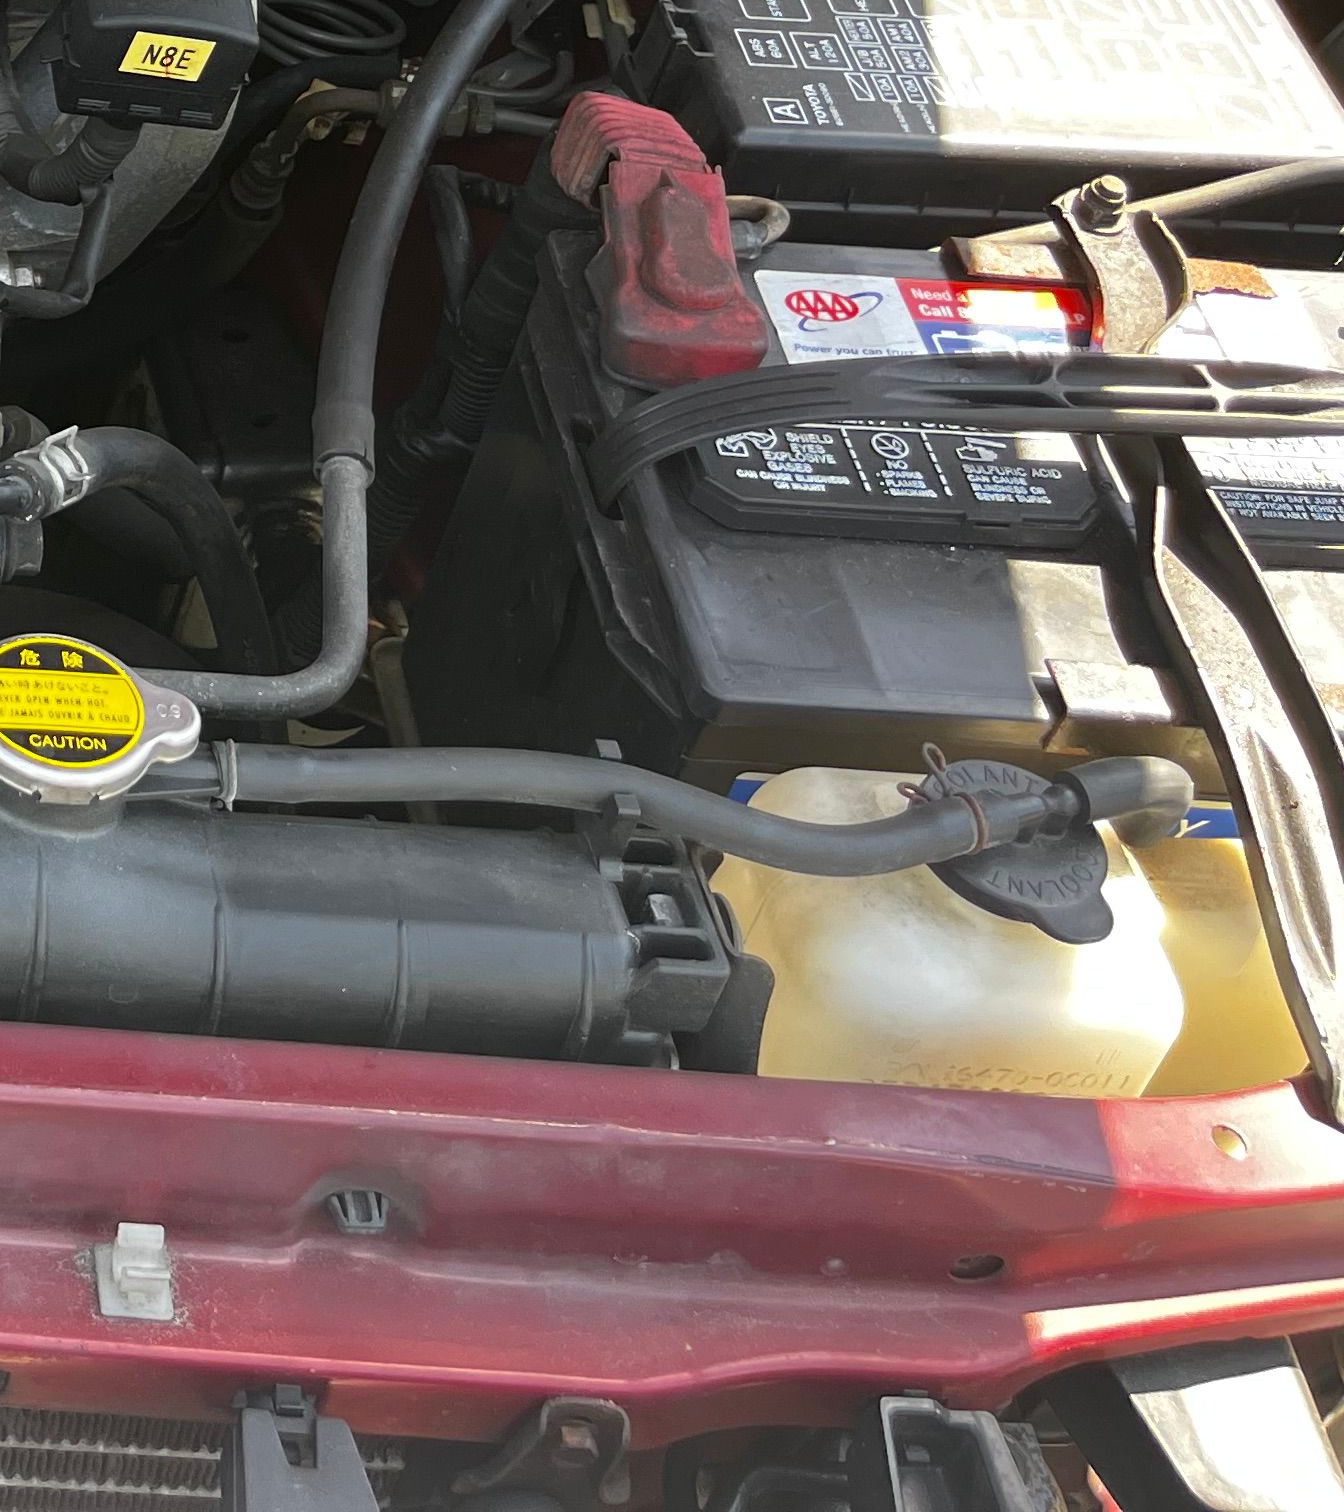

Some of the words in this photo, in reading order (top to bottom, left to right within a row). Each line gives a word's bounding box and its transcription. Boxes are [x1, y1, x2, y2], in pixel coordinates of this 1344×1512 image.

[900, 23, 914, 42] 40A
[748, 39, 766, 57] ABS
[766, 39, 782, 58] 60A
[804, 41, 821, 60] ALT
[821, 40, 838, 62] 120A
[141, 44, 196, 70] N8E
[774, 104, 800, 119] A
[803, 84, 829, 125] TOYOTA
[911, 287, 952, 302] Need
[792, 290, 850, 321] AAA
[918, 304, 952, 319] Call
[793, 343, 832, 354] Power
[836, 347, 858, 357] you
[862, 347, 883, 355] can
[785, 432, 834, 445] SHIELD
[790, 444, 825, 454] EYES
[763, 451, 836, 464] EXPLOSIVE
[767, 462, 812, 473] GASES
[886, 460, 908, 470] NO
[963, 464, 1028, 477] SULFURIC
[1031, 468, 1062, 480] ACID
[736, 470, 758, 479] CAN
[881, 470, 923, 480] SPARKS
[967, 475, 991, 484] CAN
[992, 476, 1028, 486] CAUSE
[886, 479, 927, 488] FLAMES
[1225, 500, 1291, 511] INSTRUCTIONS
[1264, 494, 1285, 502] FOR
[1287, 495, 1310, 504] SAFE
[1314, 497, 1338, 505] JUMP
[1239, 509, 1257, 517] NOT
[26, 696, 49, 705] OPEN
[55, 697, 81, 706] WHEN
[10, 708, 44, 718] JAMAIS
[48, 712, 82, 721] OUVRIR
[29, 734, 107, 752] CAUTION
[986, 848, 1100, 900] COOLANT
